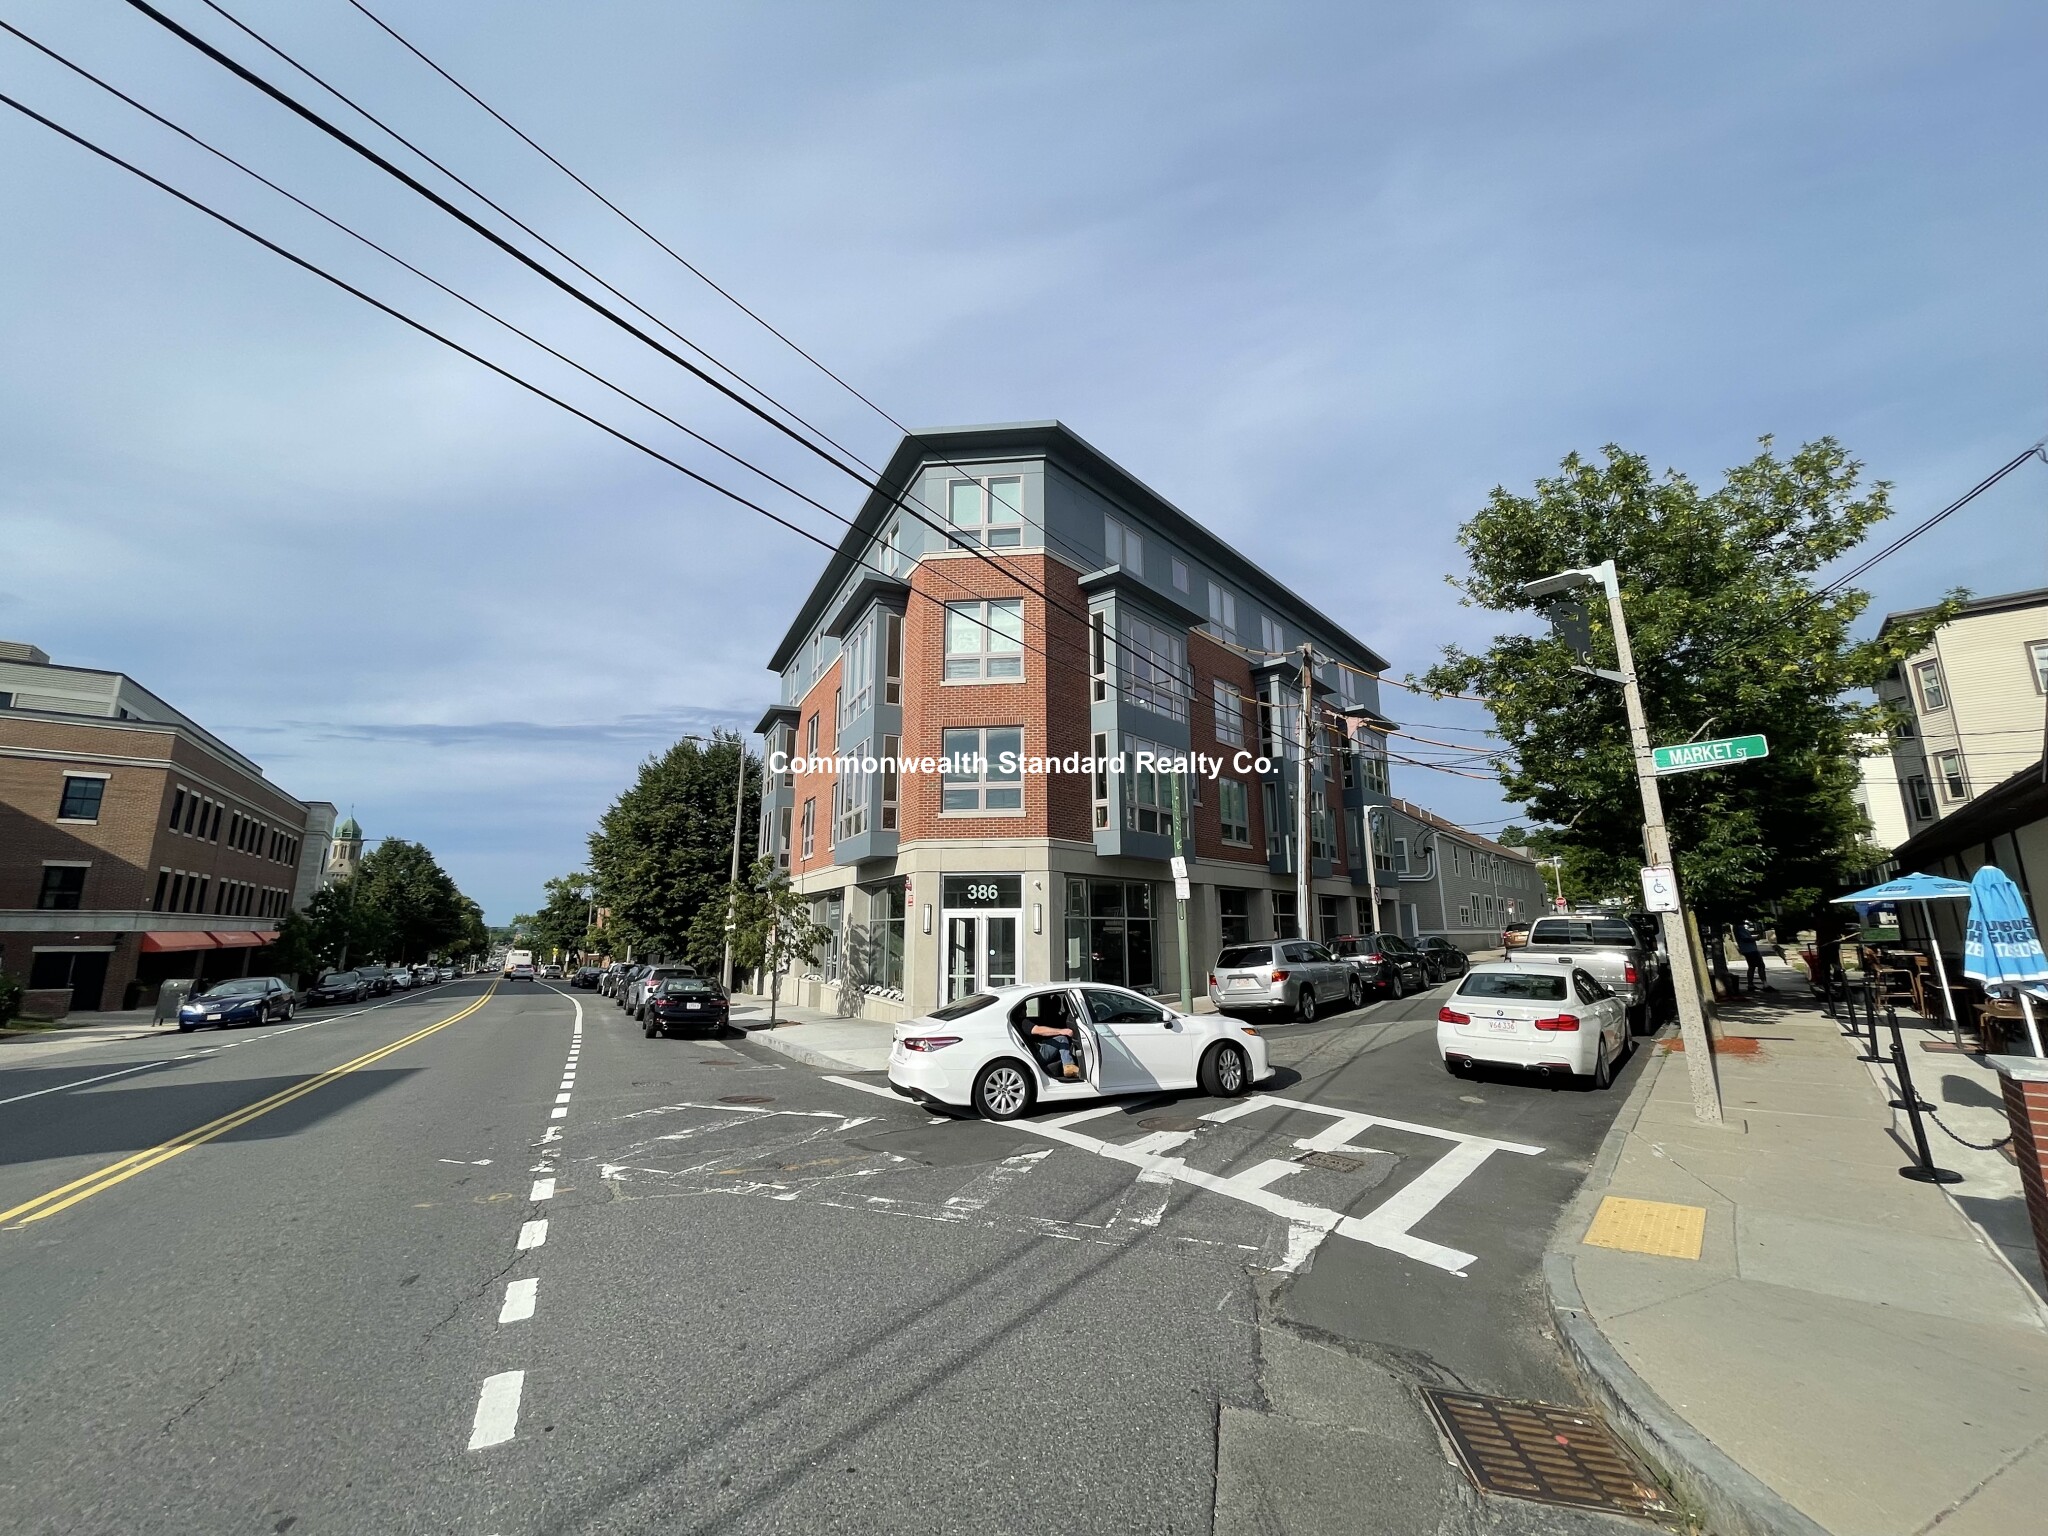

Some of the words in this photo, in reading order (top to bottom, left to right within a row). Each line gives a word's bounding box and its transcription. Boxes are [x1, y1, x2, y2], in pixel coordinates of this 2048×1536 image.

[1669, 742, 1733, 765] MARKET
[1736, 748, 1747, 757] ST
[967, 884, 998, 900] 386
